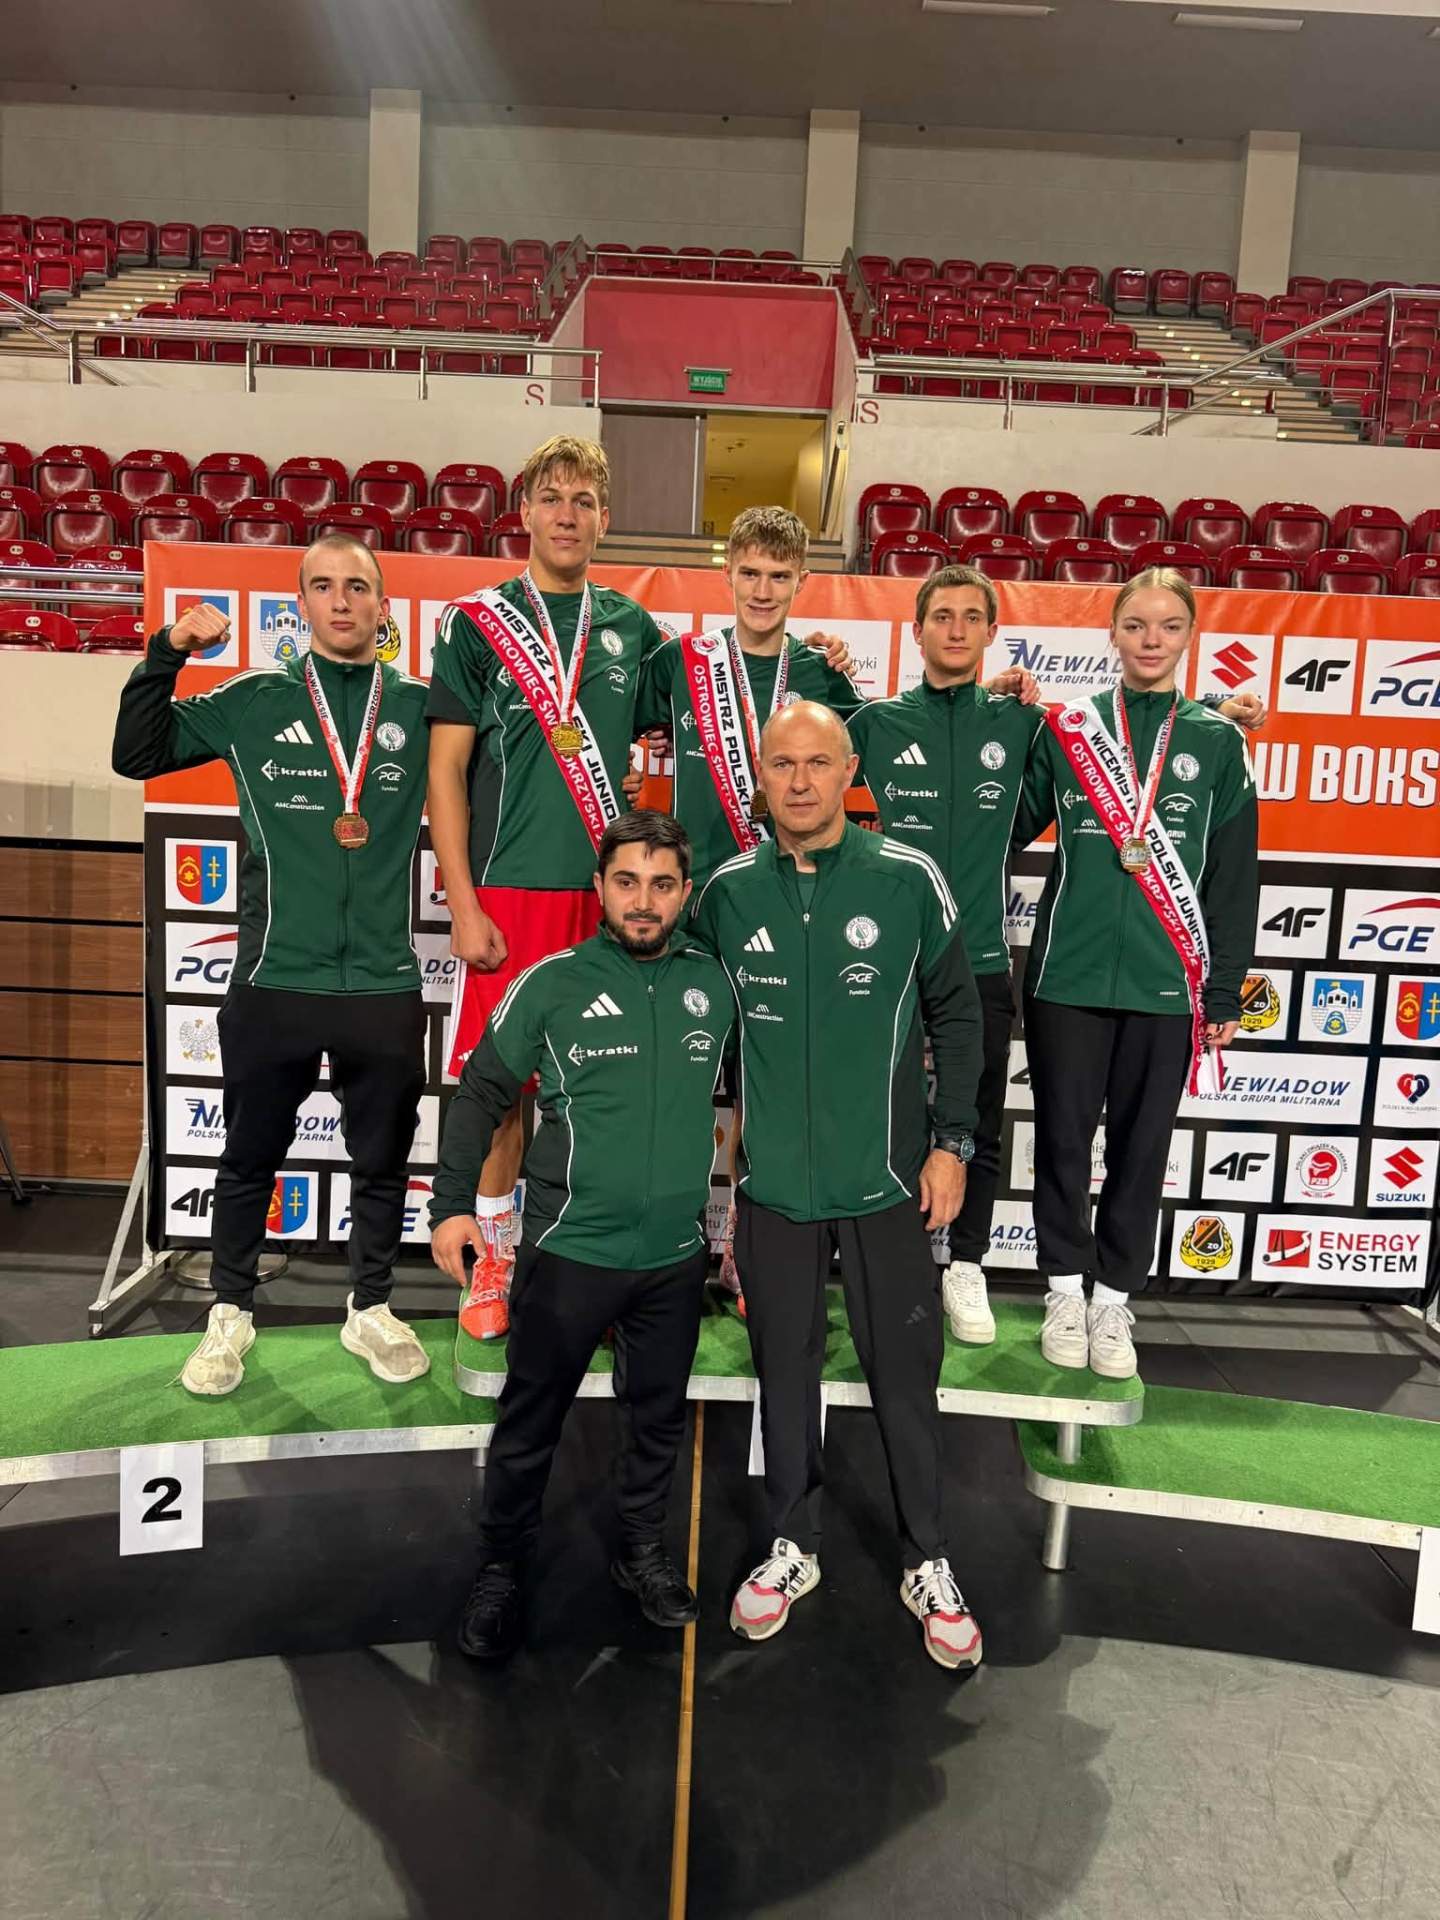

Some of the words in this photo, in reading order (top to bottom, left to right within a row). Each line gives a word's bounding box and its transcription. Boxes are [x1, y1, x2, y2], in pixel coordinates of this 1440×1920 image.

[477, 611, 546, 700] OSTROWIEC
[1055, 675, 1094, 685] GRUPA
[1097, 676, 1119, 686] MIL
[1285, 659, 1351, 692] 4F
[494, 602, 553, 671] MISTRZ
[587, 757, 618, 822] JUNIO
[693, 664, 719, 754] OSTROWIEC
[713, 661, 736, 732] MISTRZ
[725, 735, 751, 806] POLSKI
[281, 767, 328, 778] kratki
[379, 771, 401, 781] PGE
[1071, 742, 1121, 823] OSTROWIEC
[1309, 744, 1440, 808] BOKS
[897, 789, 938, 798] kratki
[978, 789, 1002, 799] PGE
[1165, 801, 1192, 813] PGE
[1146, 827, 1183, 891] POLSKI
[1007, 919, 1031, 928] SKA
[1262, 906, 1326, 938] 4F
[1349, 923, 1435, 952] PGE
[175, 957, 233, 984] PG
[748, 974, 787, 986] kratki
[846, 972, 874, 984] PGE
[587, 1045, 638, 1057] kratki
[689, 1040, 711, 1050] PGE
[1222, 1068, 1351, 1097] IEWIADOW
[1240, 1094, 1277, 1103] GRUPA
[1279, 1095, 1341, 1107] MILITARNA
[1208, 1151, 1270, 1181] 4F
[1375, 1192, 1426, 1203] SUZUKI
[1319, 1231, 1422, 1252] ENERGY
[1317, 1252, 1418, 1273] SYSTEM
[141, 1476, 183, 1524] 2
